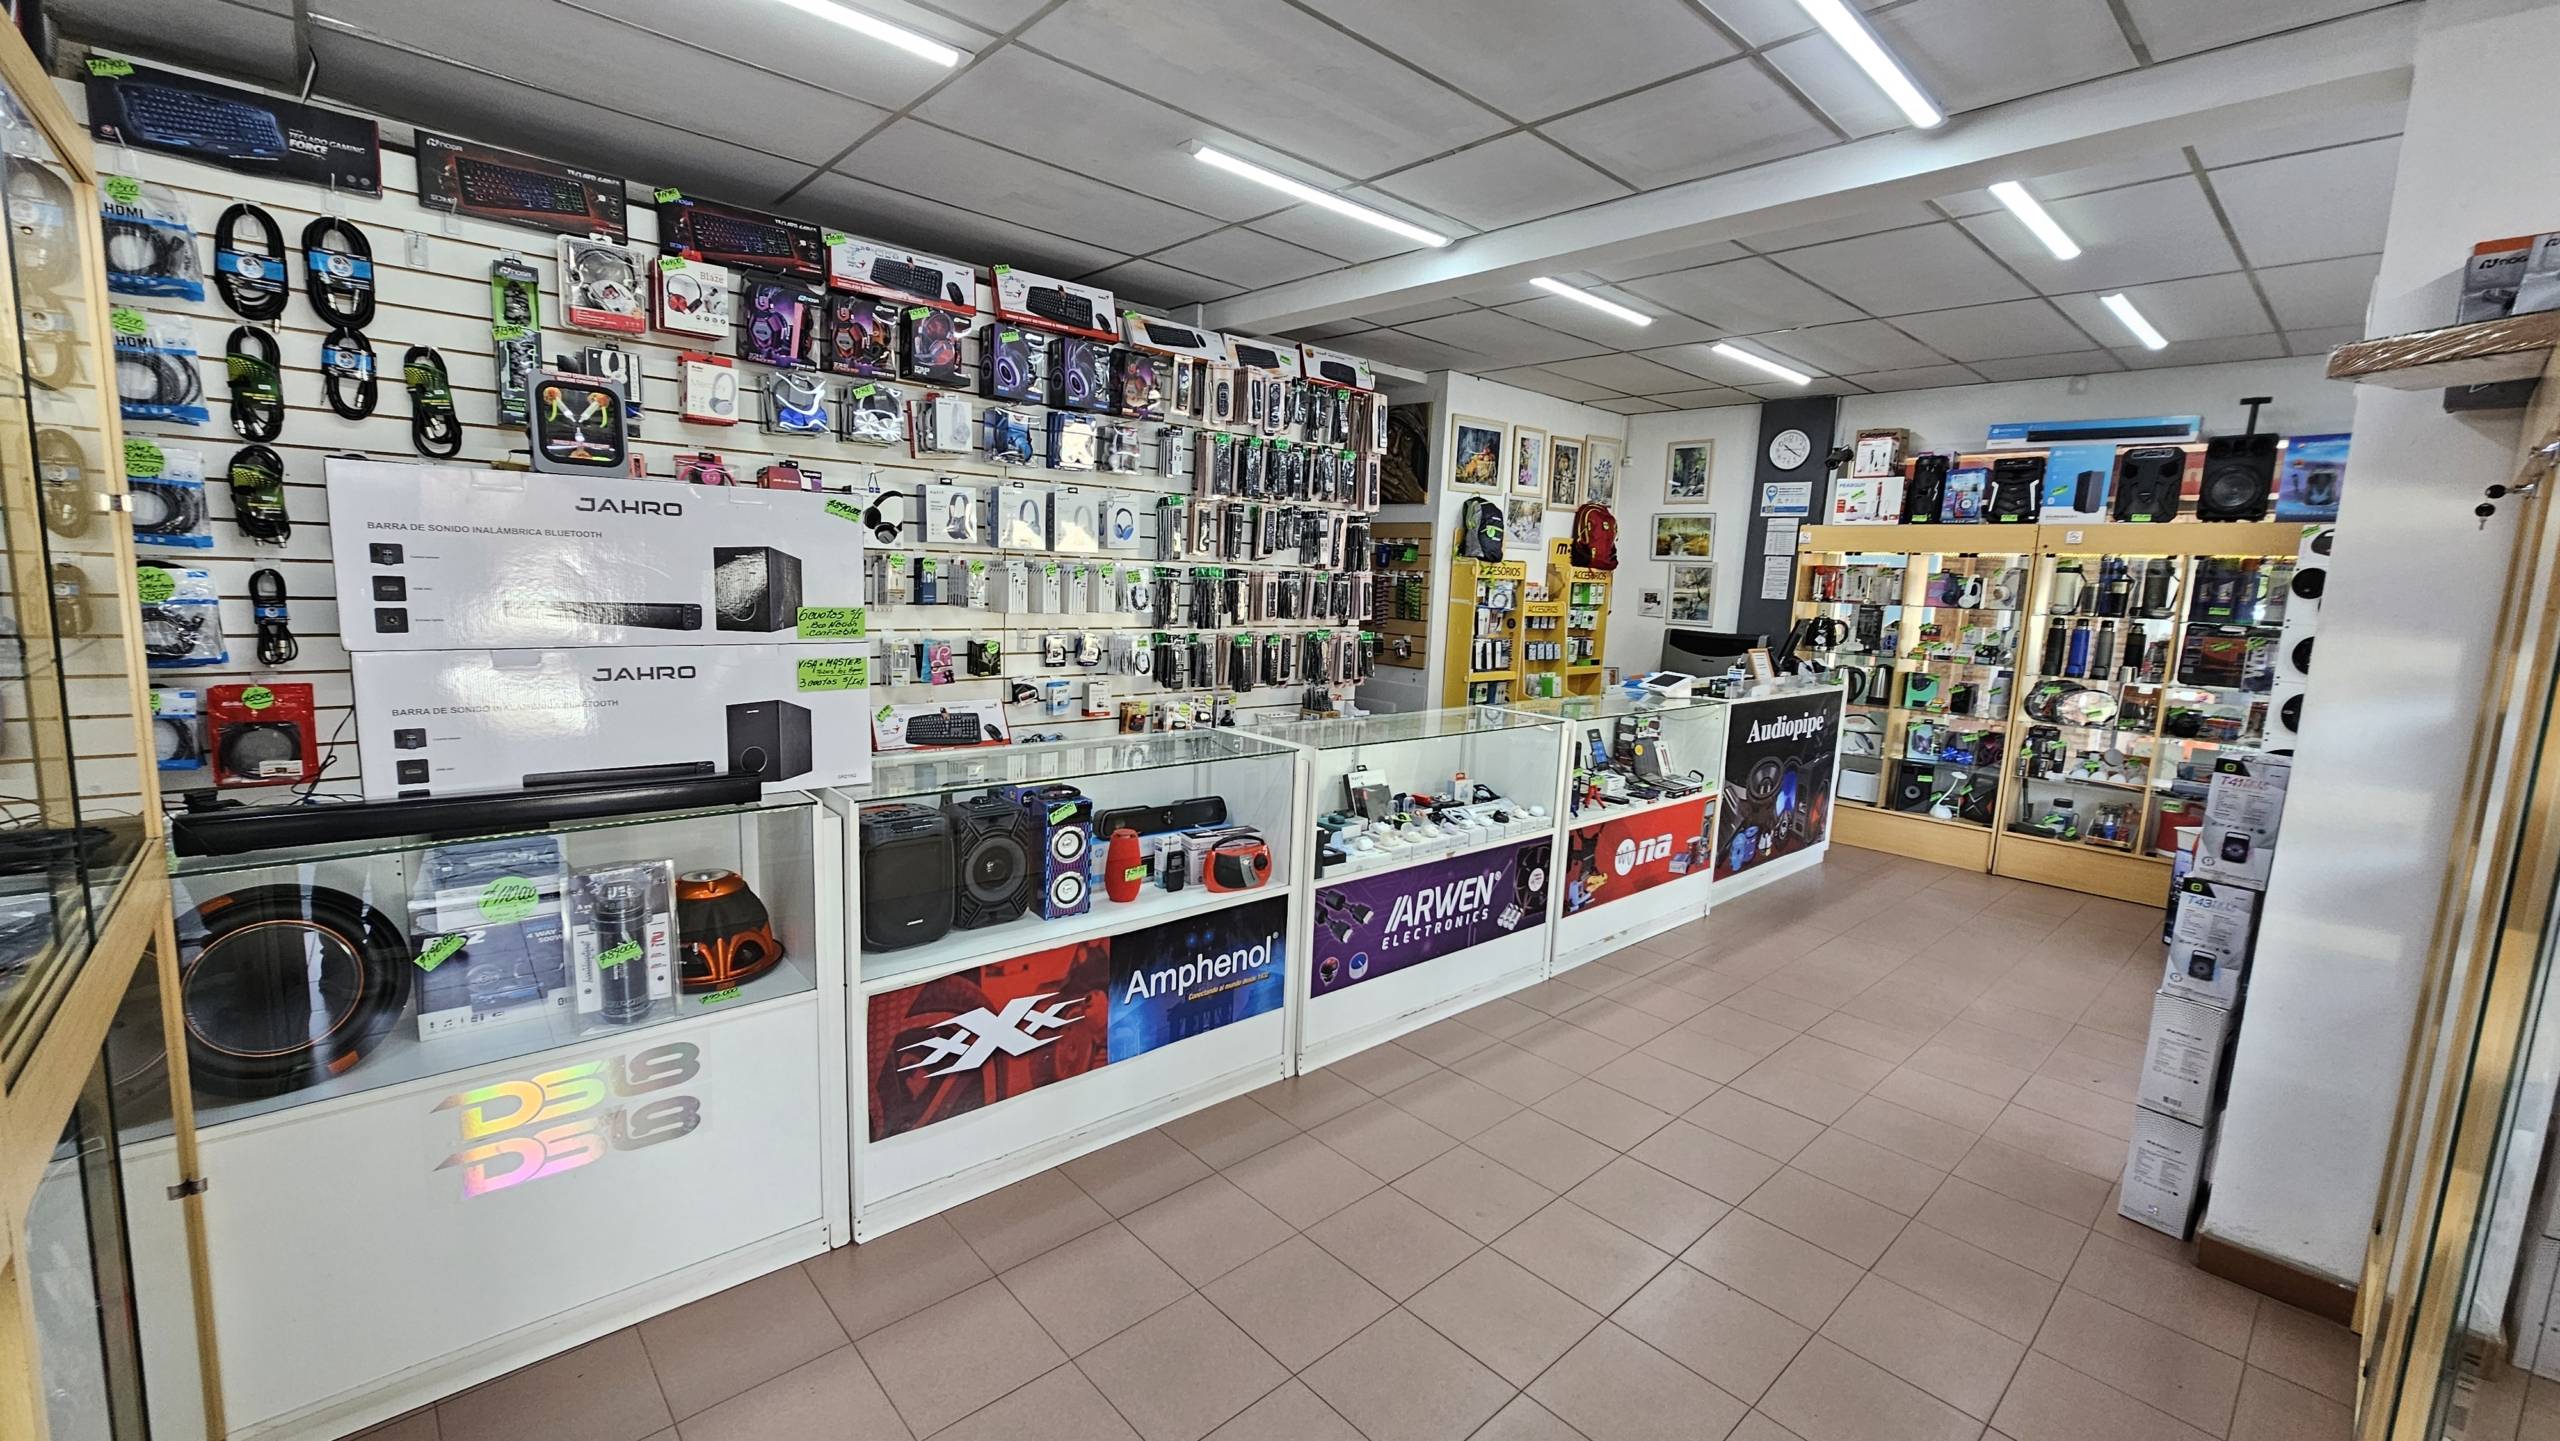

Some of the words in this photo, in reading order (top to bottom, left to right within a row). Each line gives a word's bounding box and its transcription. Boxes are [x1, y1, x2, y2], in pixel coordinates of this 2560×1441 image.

[288, 139, 328, 155] FORCE
[289, 130, 328, 146] TECLADO
[329, 141, 365, 154] GAMING
[104, 202, 145, 219] HDMI
[115, 335, 155, 349] HDMI
[575, 497, 682, 517] JAHRO
[367, 521, 408, 531] BARRA
[410, 523, 425, 532] DE
[428, 524, 470, 534] SONIDO
[545, 529, 603, 539] BLUETOOTH
[592, 665, 696, 681] JAHRO
[392, 708, 431, 717] BARRA
[432, 707, 448, 715] DE
[1746, 712, 1825, 743] Audiopipe
[1384, 872, 1494, 934] ARWEN
[1382, 908, 1489, 951] ELECTRONICS
[1123, 936, 1272, 1006] Amphenol
